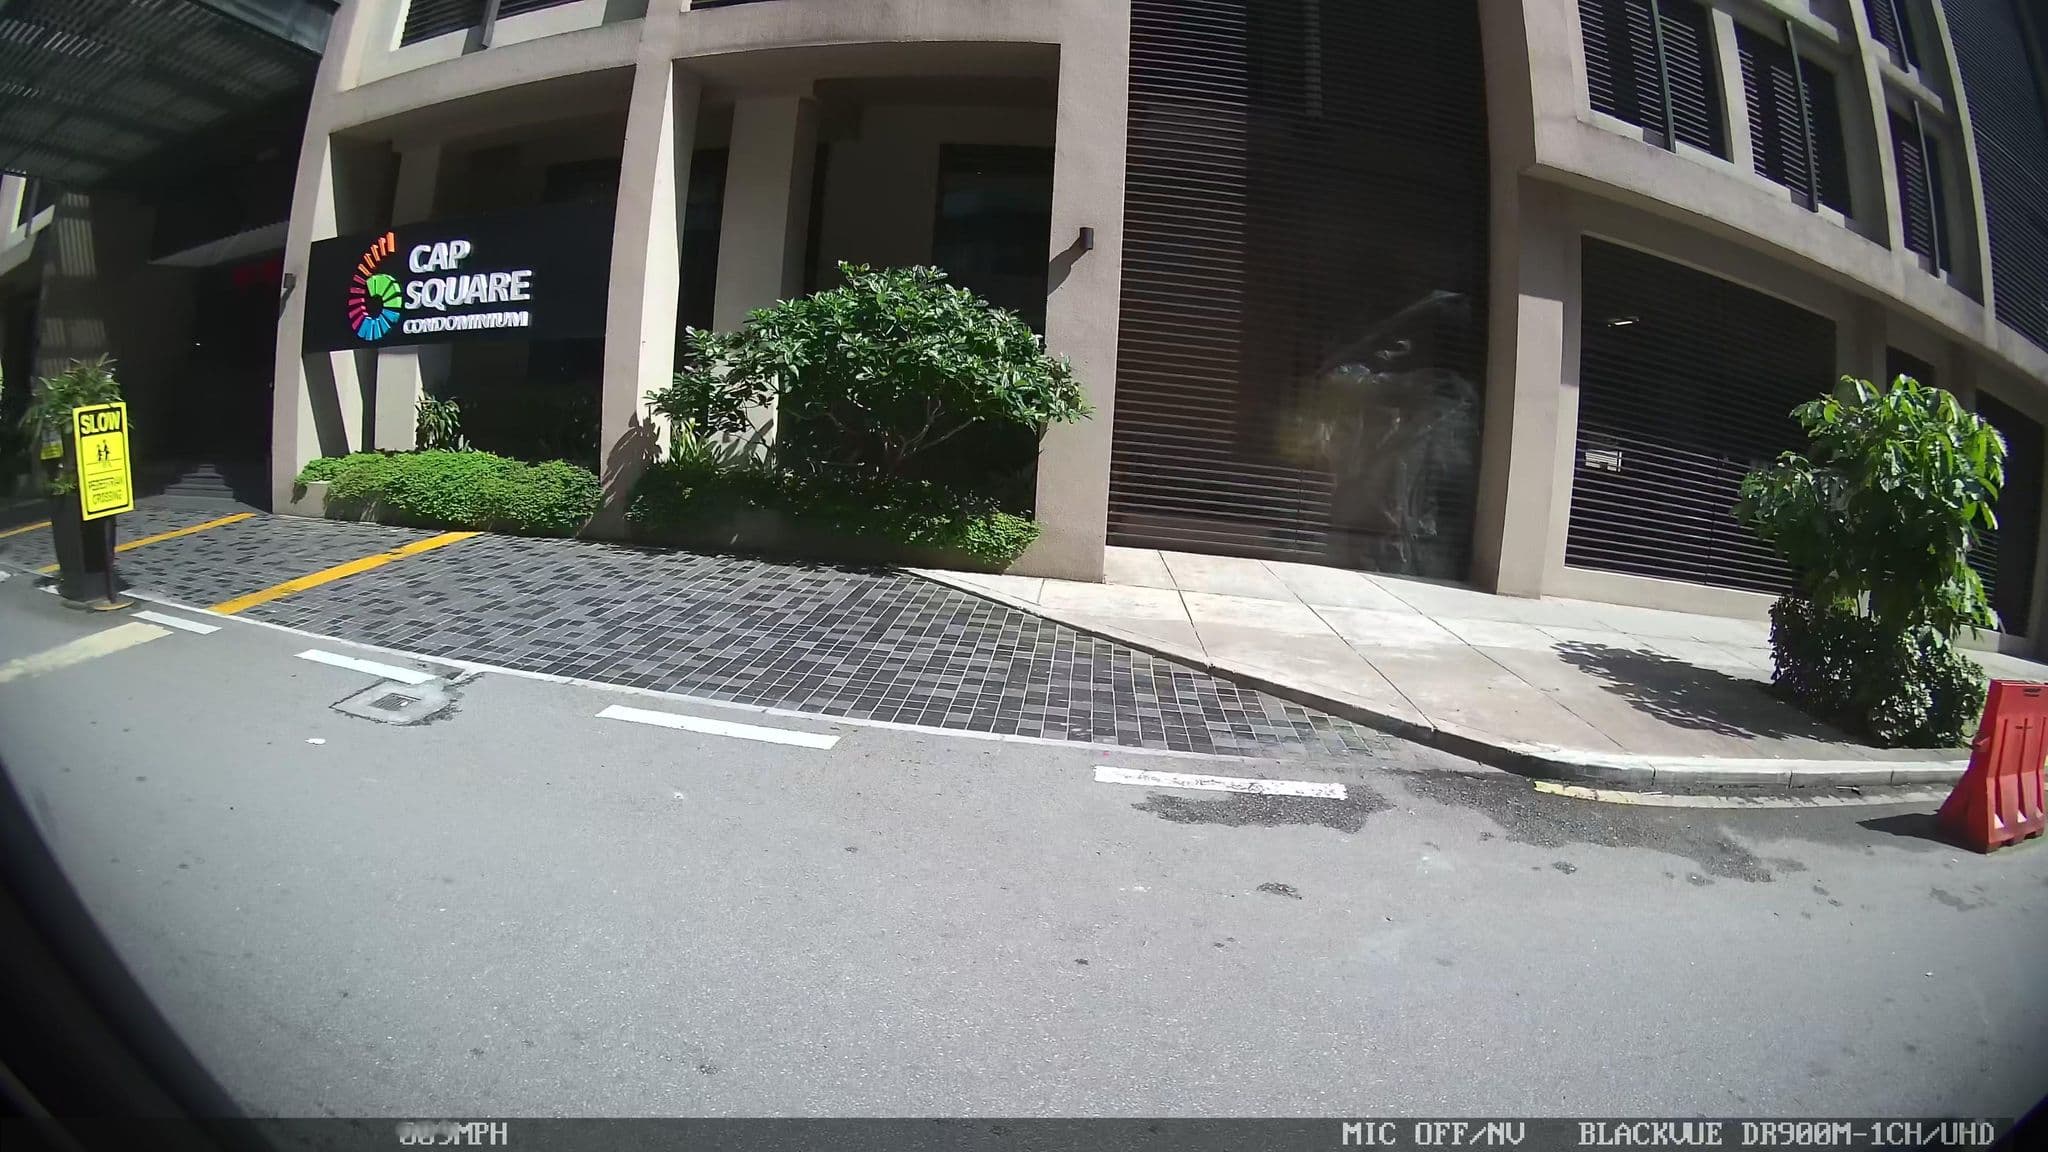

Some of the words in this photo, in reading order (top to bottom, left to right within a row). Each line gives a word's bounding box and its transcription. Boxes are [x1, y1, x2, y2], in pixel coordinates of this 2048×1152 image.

[409, 239, 471, 273] CAP
[404, 270, 532, 311] SQUARE
[403, 311, 529, 334] CONDOMINIUM
[80, 411, 121, 434] SLOW
